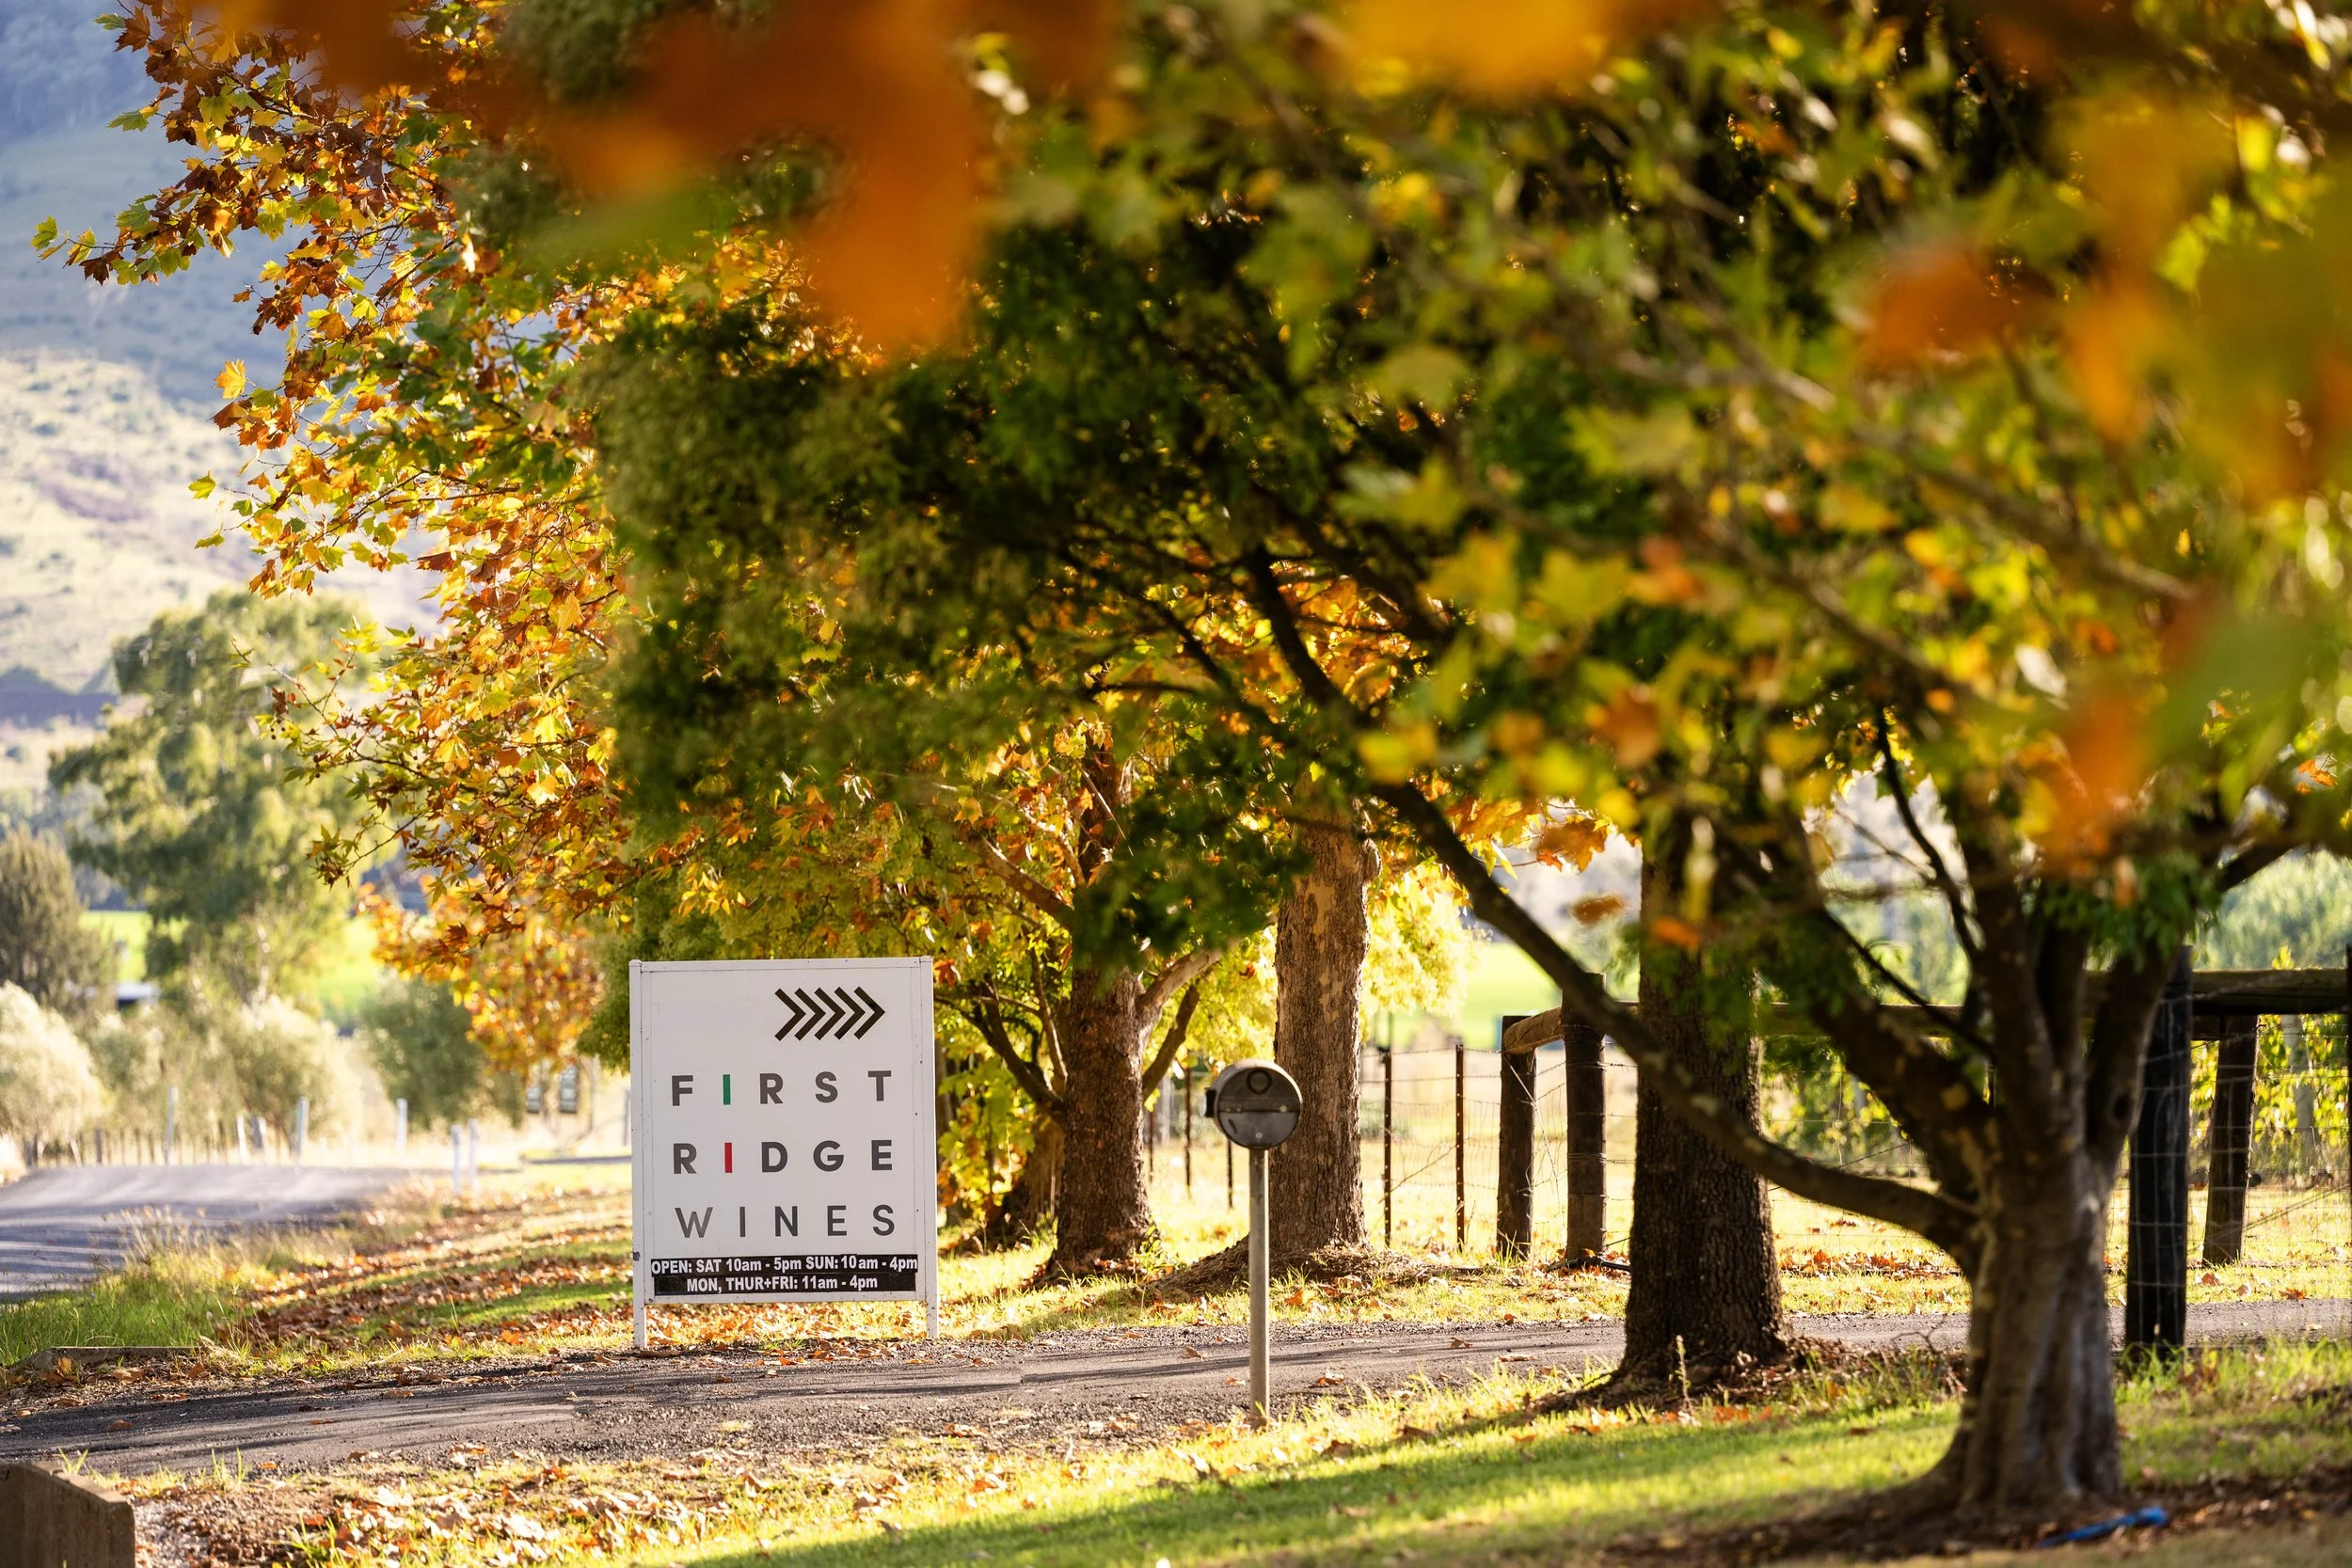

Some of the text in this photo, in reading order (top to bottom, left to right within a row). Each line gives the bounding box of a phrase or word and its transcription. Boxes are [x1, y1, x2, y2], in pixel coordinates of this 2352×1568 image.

[671, 1070, 892, 1106] FIRST
[673, 1139, 893, 1174] RIDGE
[675, 1204, 895, 1238] WINES
[651, 1260, 692, 1275] OPEN:
[696, 1259, 722, 1274] SAT
[725, 1258, 762, 1272] 10am
[773, 1257, 802, 1273] 5pm
[805, 1256, 839, 1270] SUN:
[889, 1256, 919, 1271] 4pm
[687, 1277, 722, 1293] MON,
[725, 1276, 798, 1291] THUR+FRI:
[802, 1275, 837, 1290] 11am
[850, 1275, 878, 1291] 4pm
